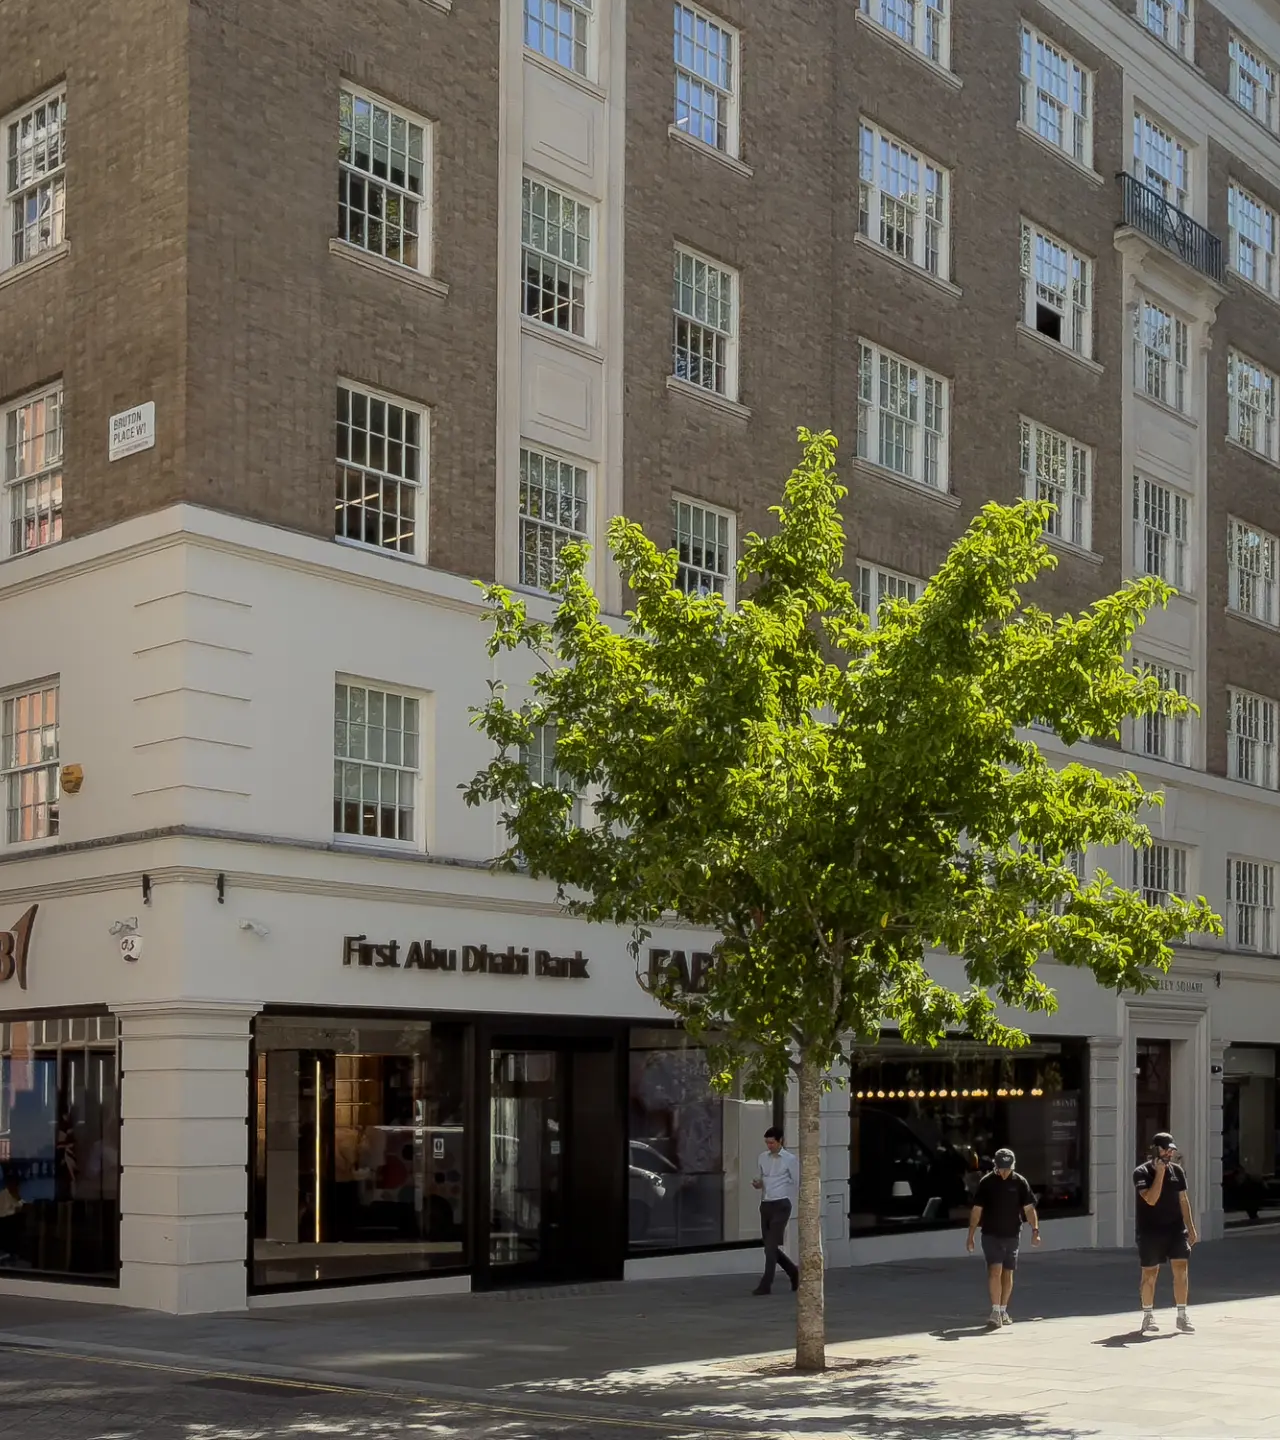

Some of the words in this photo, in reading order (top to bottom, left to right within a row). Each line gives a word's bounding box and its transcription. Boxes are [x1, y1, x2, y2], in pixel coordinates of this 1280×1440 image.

[113, 409, 142, 431] BRUTON
[113, 425, 135, 445] PLACE
[135, 422, 147, 437] W1
[342, 934, 400, 968] First
[403, 939, 457, 971] Abu
[461, 944, 530, 976] Dhabi
[534, 949, 591, 979] Bank
